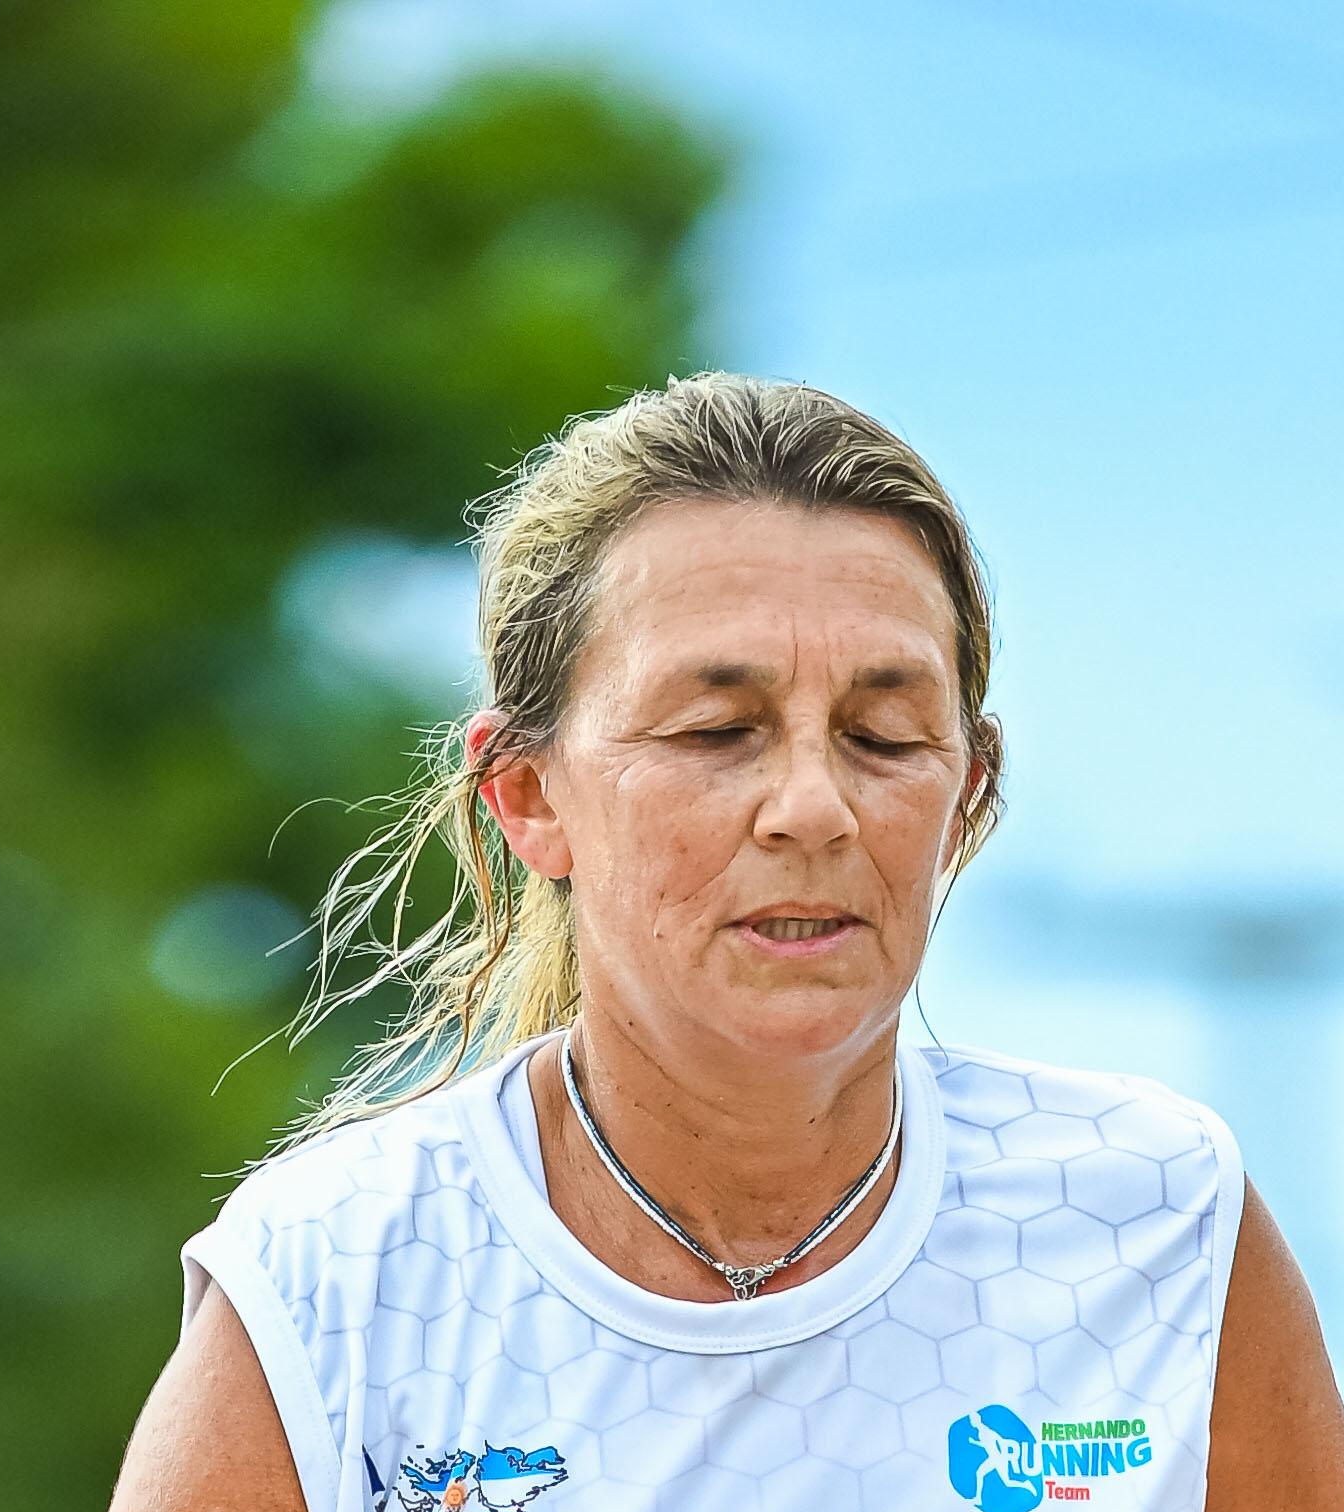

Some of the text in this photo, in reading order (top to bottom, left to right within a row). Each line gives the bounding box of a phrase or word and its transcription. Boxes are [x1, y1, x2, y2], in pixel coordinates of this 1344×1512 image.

[1041, 1419, 1146, 1441] HERNANDO
[1001, 1437, 1152, 1477] RUNNING
[1045, 1481, 1090, 1500] Team
